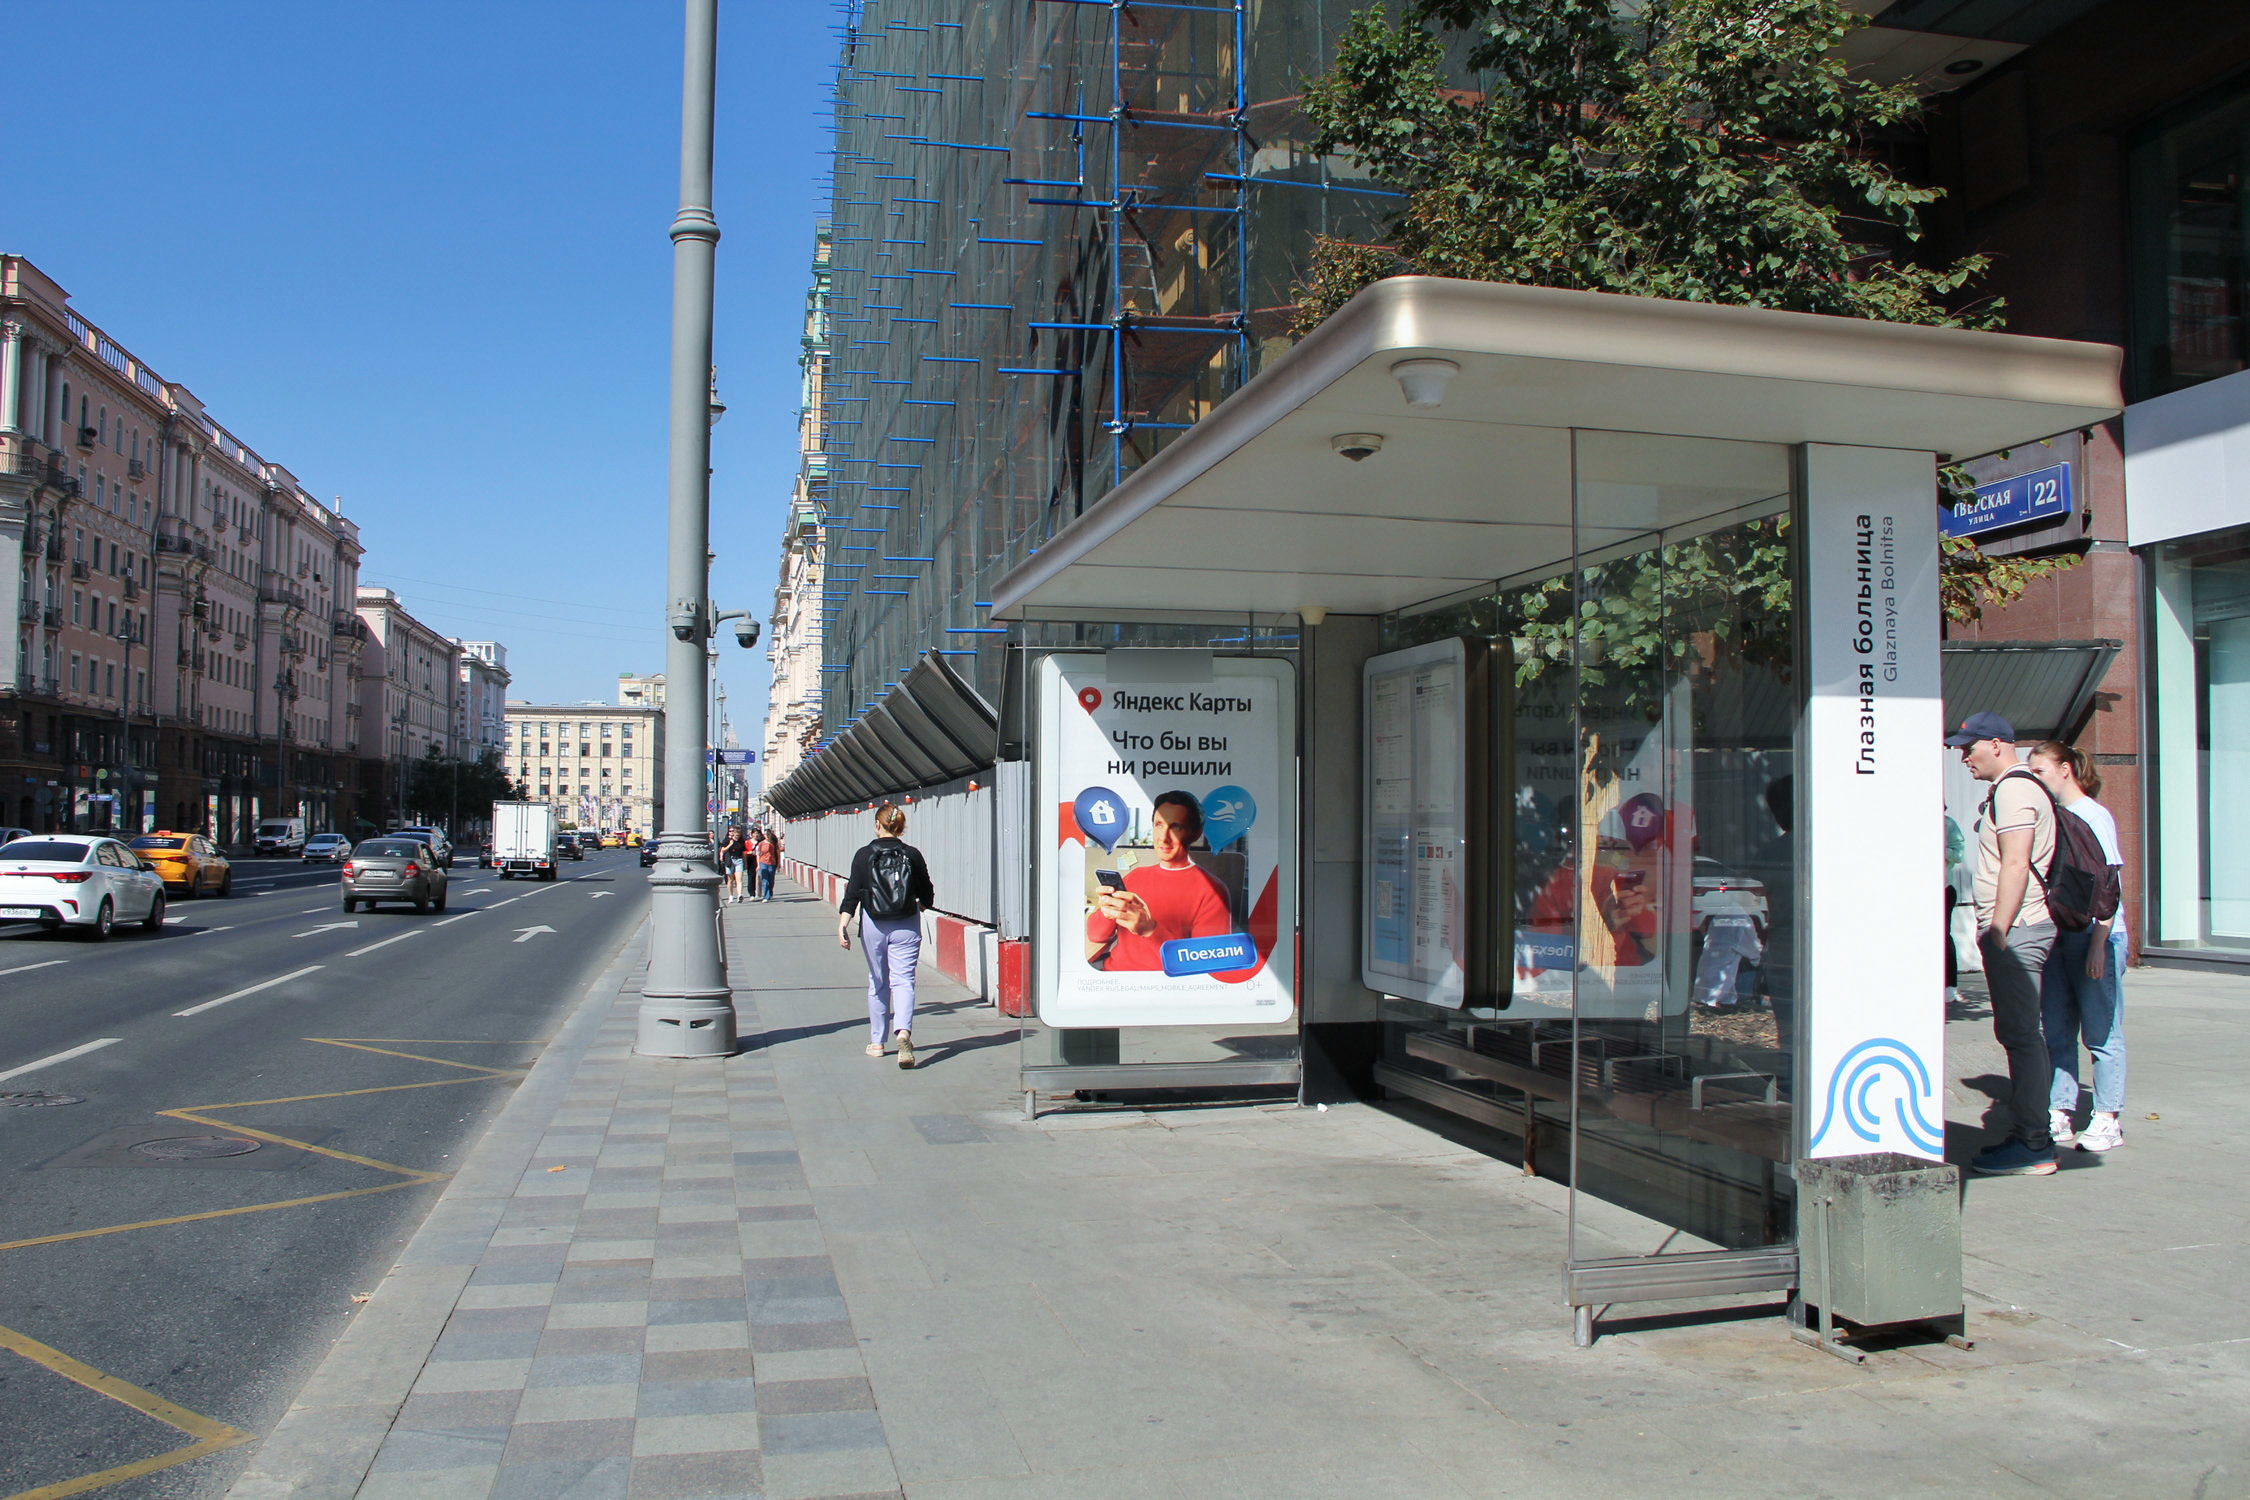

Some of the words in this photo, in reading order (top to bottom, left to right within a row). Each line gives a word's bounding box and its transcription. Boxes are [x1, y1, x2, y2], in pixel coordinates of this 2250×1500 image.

[2034, 479, 2057, 506] 22
[1968, 512, 1995, 526] УЛИЦА
[1880, 515, 1895, 590] Bolnitsa
[1853, 513, 1875, 654] больница
[1882, 597, 1899, 682] Glaznaya
[1113, 690, 1184, 713] Яндекс
[1189, 692, 1252, 715] Карты
[1856, 663, 1875, 775] Глазная
[1113, 730, 1154, 750] Что
[1160, 730, 1191, 750] бы
[1198, 736, 1227, 751] вы
[1107, 760, 1135, 775] ни
[1142, 760, 1231, 779] решили
[1177, 946, 1244, 963] Поехали
[1246, 980, 1263, 991] 0+
